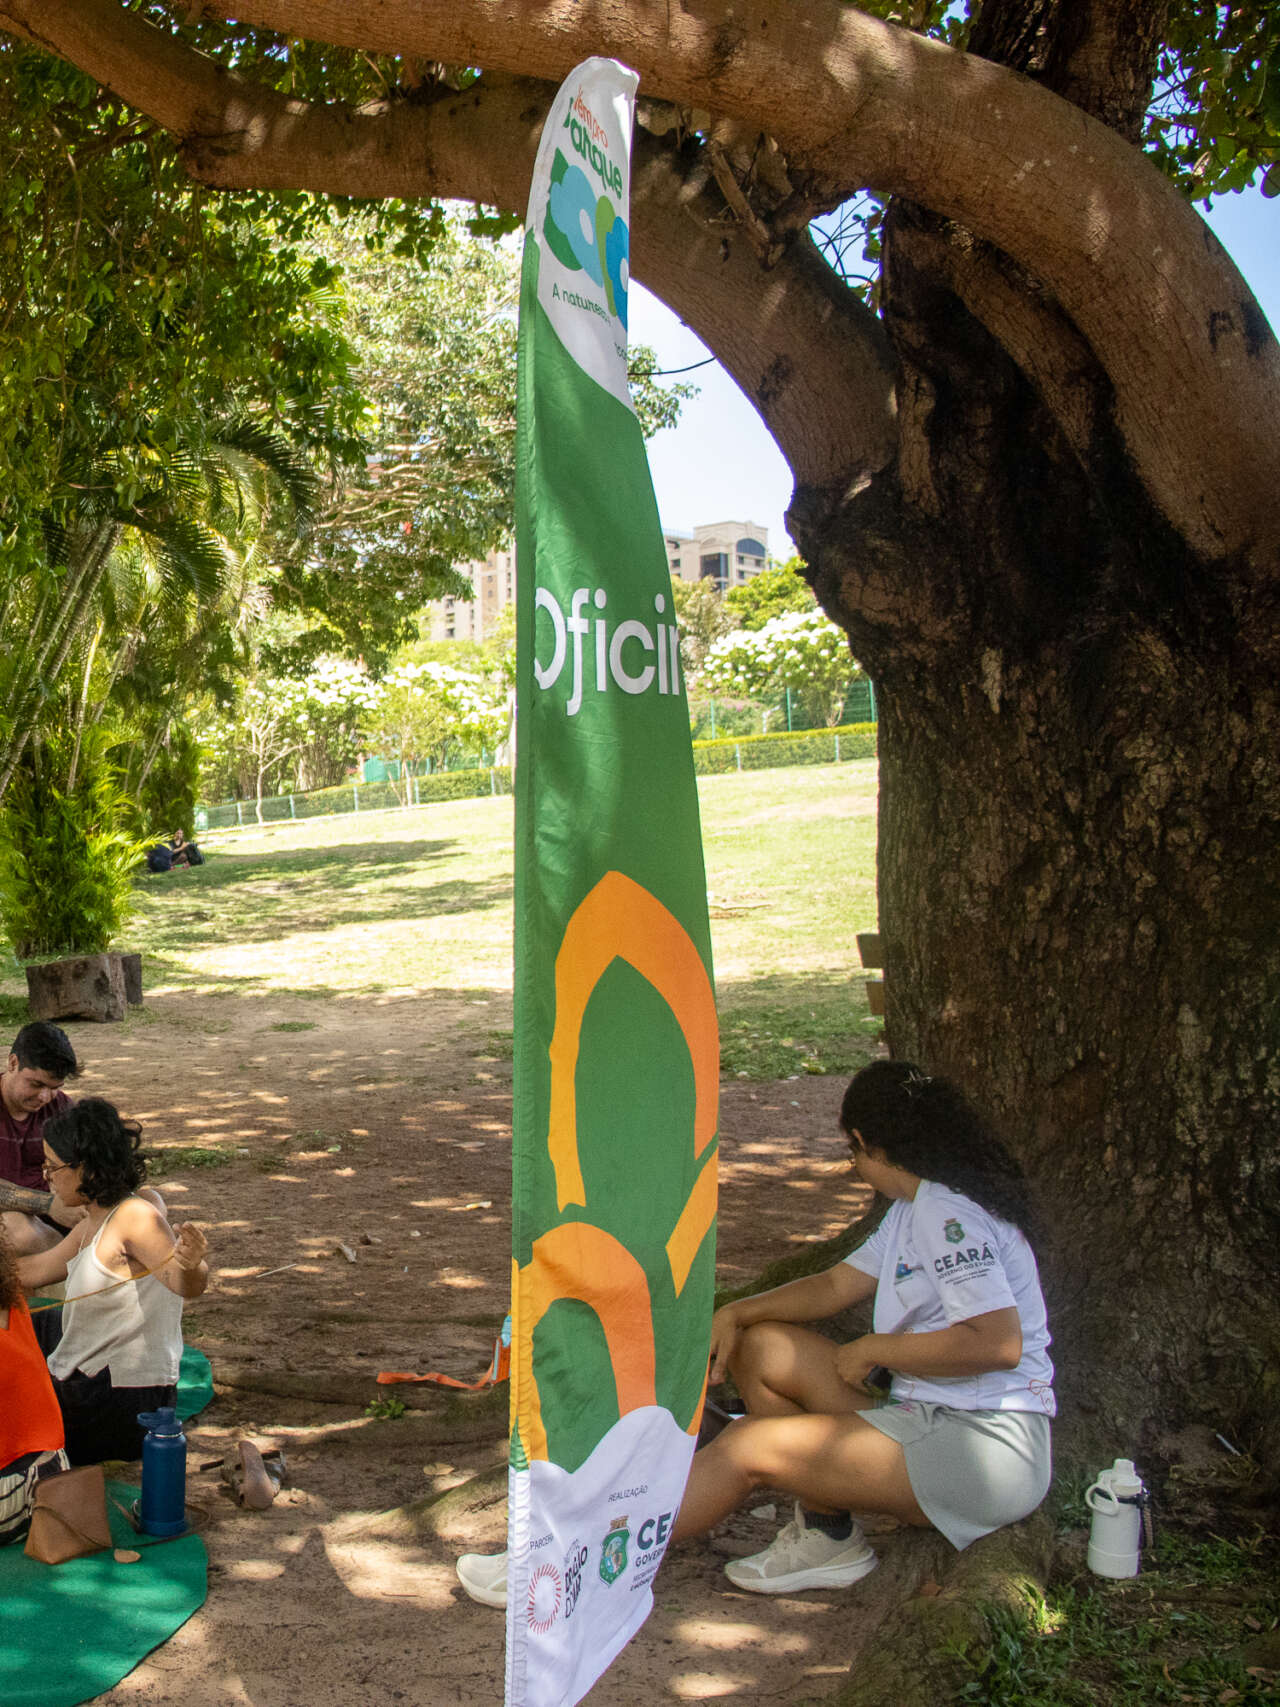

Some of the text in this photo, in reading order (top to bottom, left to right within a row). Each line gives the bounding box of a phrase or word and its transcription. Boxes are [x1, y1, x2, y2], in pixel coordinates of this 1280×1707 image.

[552, 282, 561, 300] A
[934, 1241, 995, 1273] CEARÁ
[608, 1485, 648, 1502] REALIZAÇÃO
[637, 1503, 678, 1550] CE
